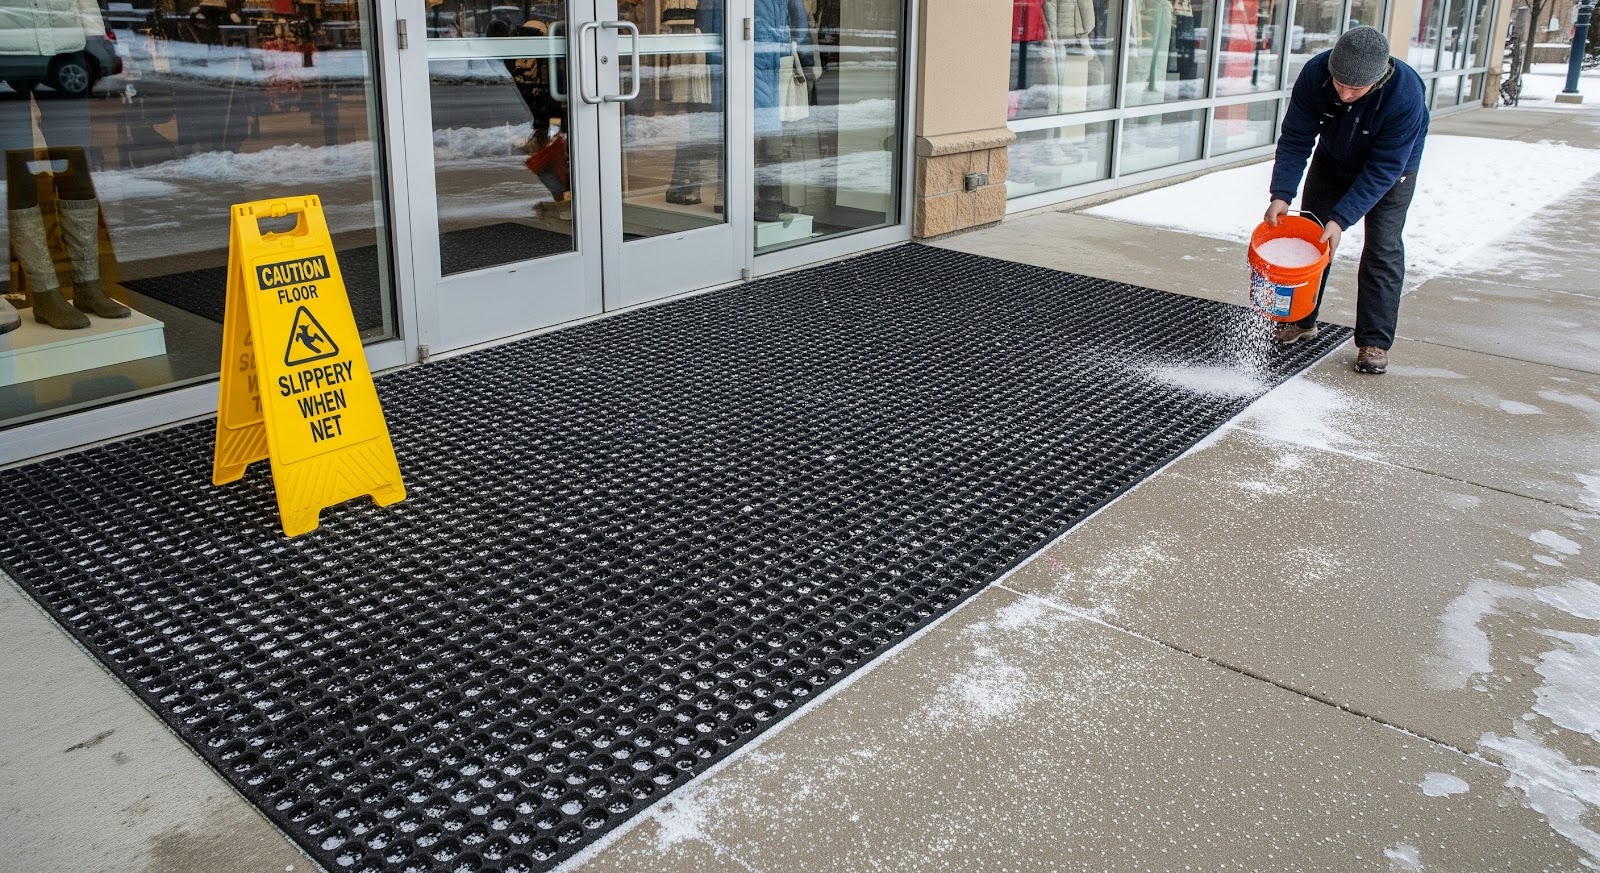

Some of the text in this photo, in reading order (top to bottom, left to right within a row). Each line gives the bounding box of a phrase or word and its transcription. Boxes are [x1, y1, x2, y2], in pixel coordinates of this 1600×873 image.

[261, 258, 325, 287] CAUTION
[277, 284, 319, 305] FLOOR
[278, 360, 353, 397] SLIPPERY
[297, 388, 347, 419] WHEN
[309, 414, 342, 443] NET
